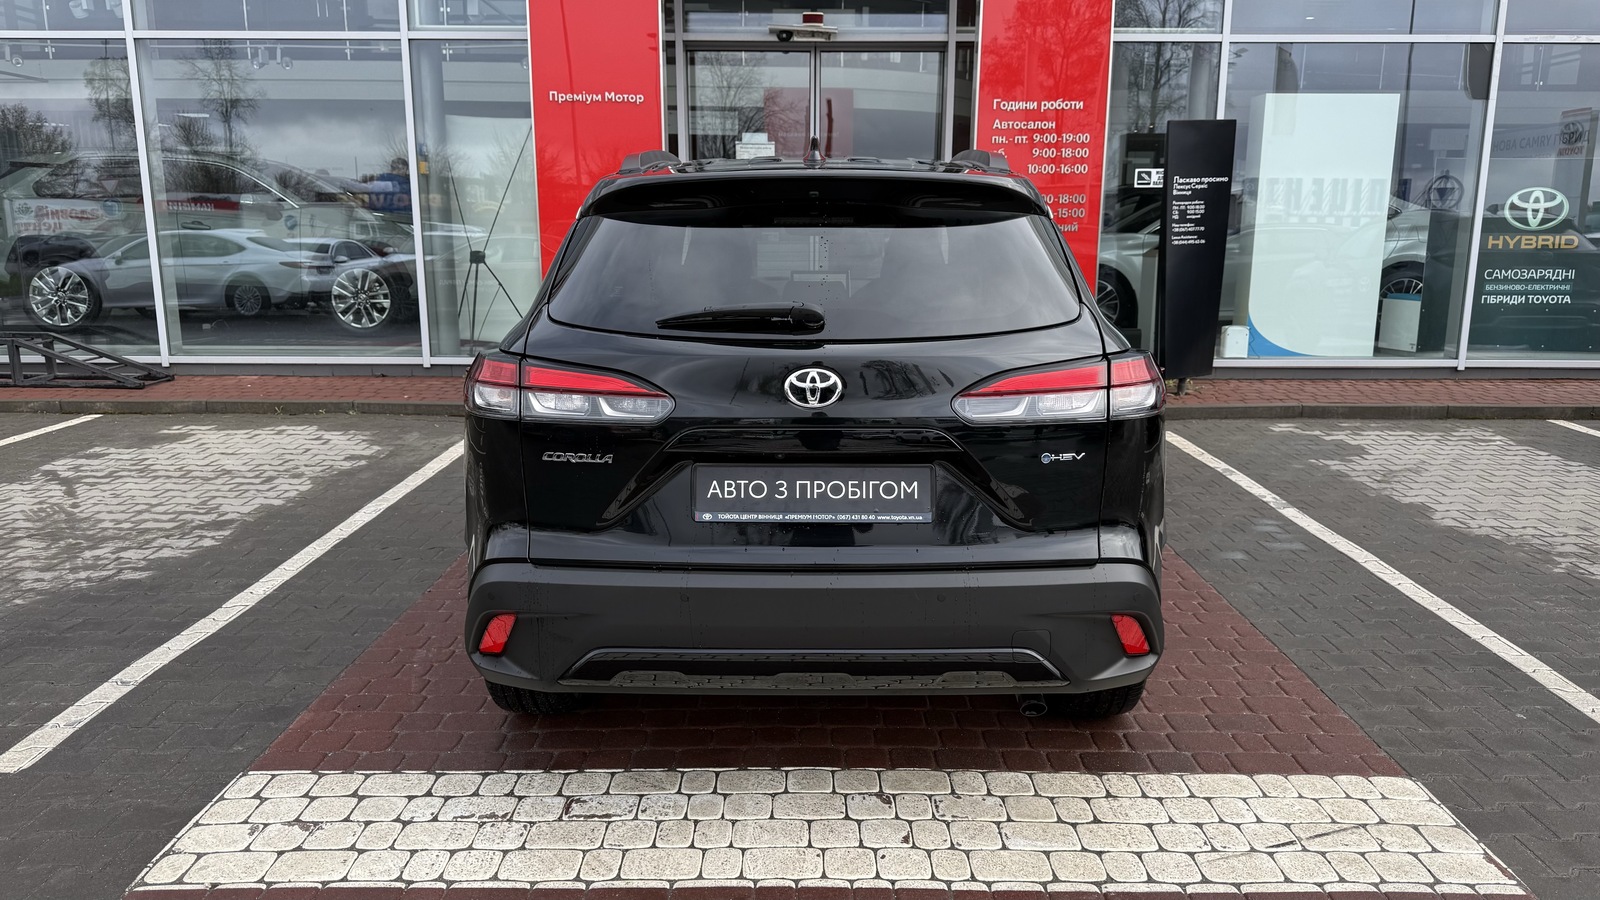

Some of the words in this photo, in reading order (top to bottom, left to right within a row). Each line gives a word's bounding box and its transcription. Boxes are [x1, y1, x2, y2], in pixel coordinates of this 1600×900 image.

[549, 90, 602, 105] Преміум
[604, 91, 644, 104] Мотор
[993, 98, 1038, 111] Години
[1040, 98, 1084, 112] роботи
[992, 120, 1056, 130] Автосалон
[1033, 133, 1090, 144] 9:00-19:00
[1032, 148, 1089, 158] 9:00-18:00
[1027, 164, 1088, 174] 10:00-16:00
[1487, 235, 1580, 250] HYBRID
[1484, 268, 1575, 281] САМОЗАРЯДНІ
[1482, 295, 1526, 304] ГІБРИДИ
[1528, 295, 1571, 304] TOYOTA
[542, 452, 614, 464] COROLLA
[707, 480, 767, 499] АВТО
[796, 480, 918, 499] ПРОБІГОМ
